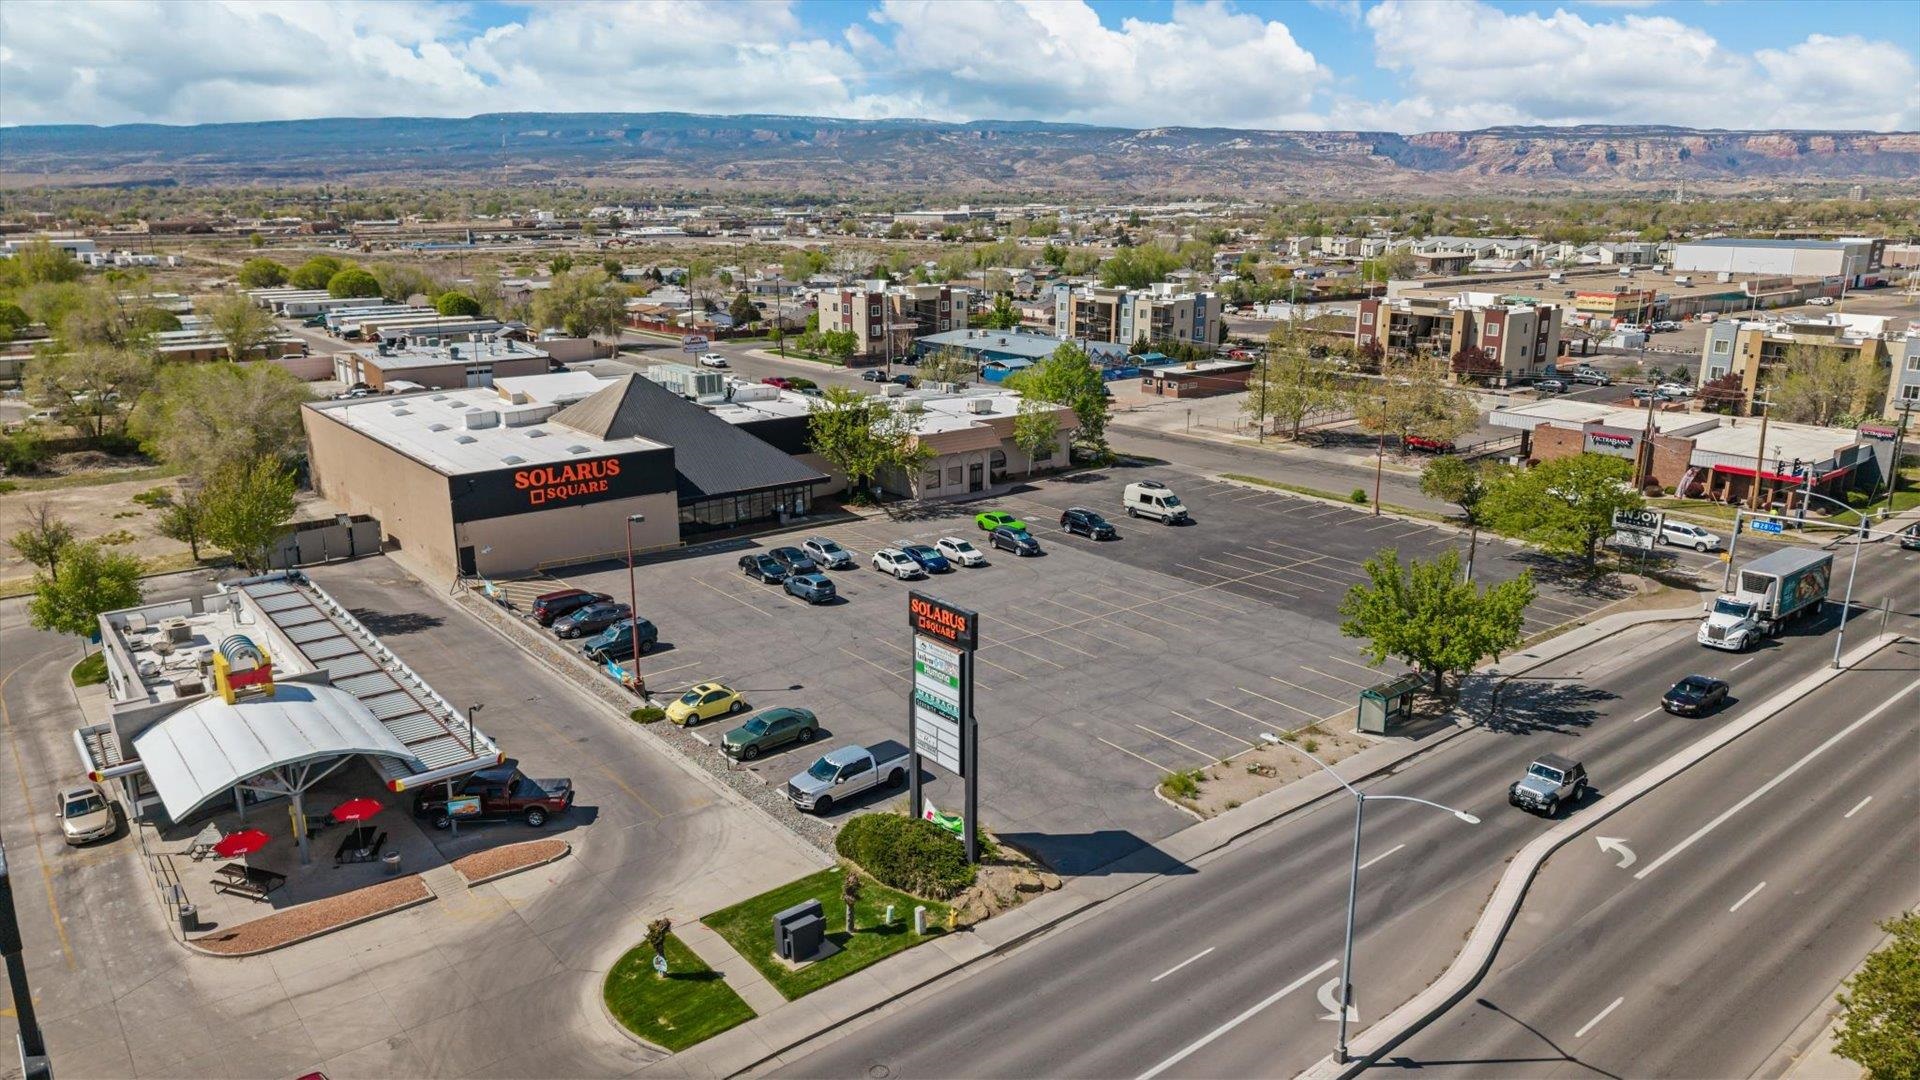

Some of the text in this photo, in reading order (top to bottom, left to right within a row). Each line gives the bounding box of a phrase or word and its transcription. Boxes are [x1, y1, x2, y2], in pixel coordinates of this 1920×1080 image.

[1590, 435, 1630, 446] VECTRABANK
[515, 459, 621, 489] SOLARUS
[547, 480, 609, 499] SQUARE
[1616, 510, 1658, 523] ENJOY
[911, 599, 965, 632] SOLARUS
[926, 620, 956, 639] SQUARE
[924, 664, 950, 683] Humana
[917, 689, 958, 711] MASSAGE
